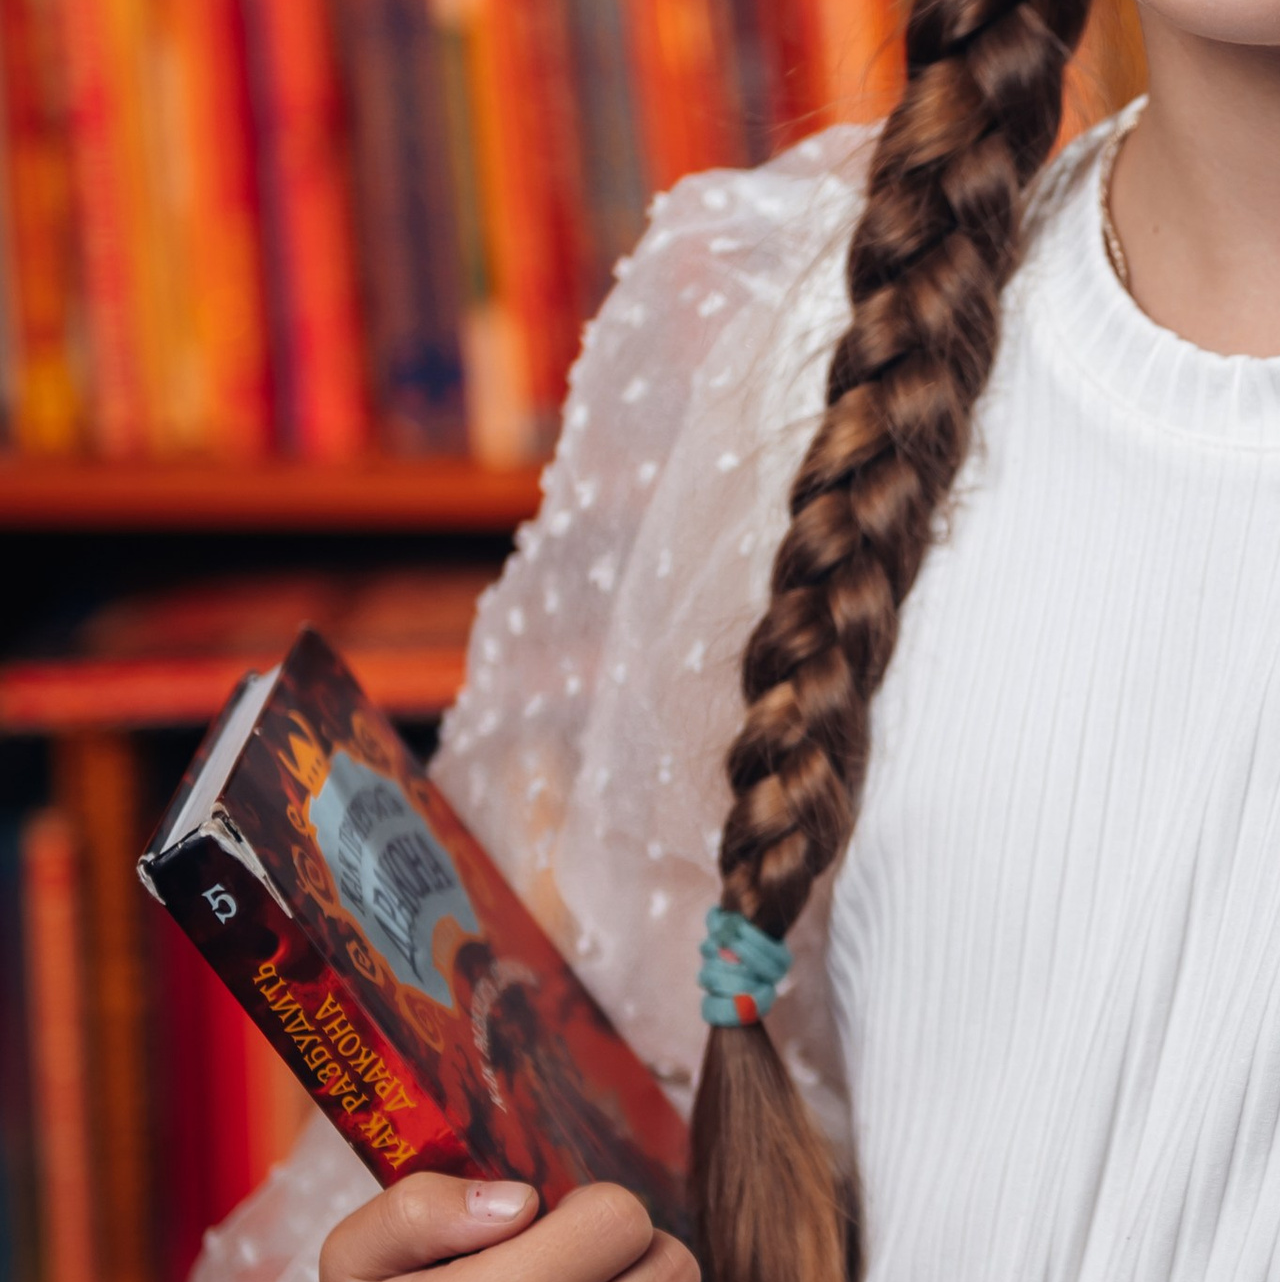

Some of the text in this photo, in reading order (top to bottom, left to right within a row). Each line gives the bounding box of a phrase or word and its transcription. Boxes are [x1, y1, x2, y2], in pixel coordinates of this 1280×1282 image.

[202, 883, 238, 925] 5
[371, 830, 455, 984] ДРАКОНА
[253, 962, 418, 1170] КАК РАЗБУДИТЬ
[315, 992, 416, 1113] ДРАКОНА
